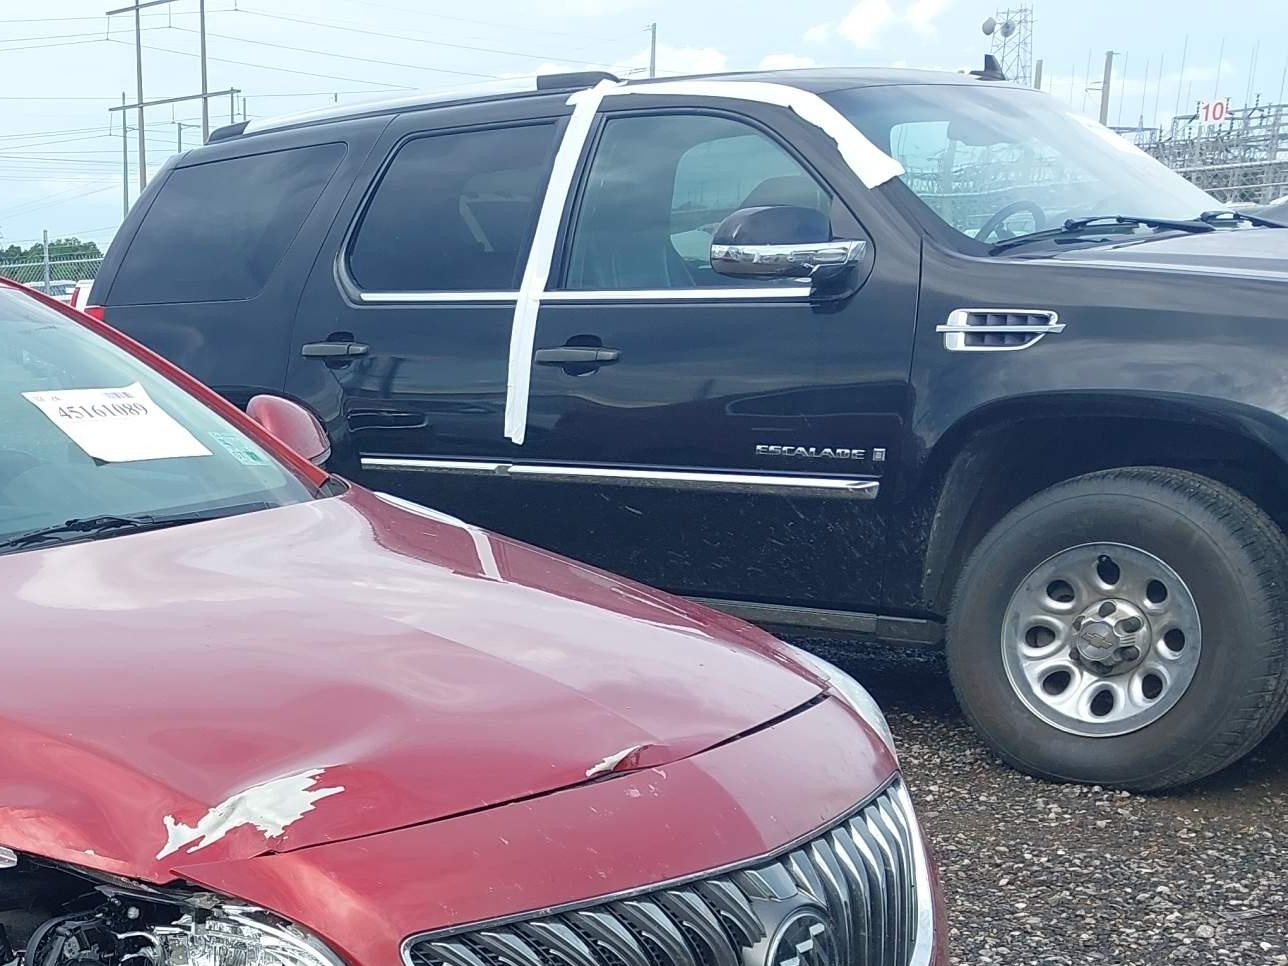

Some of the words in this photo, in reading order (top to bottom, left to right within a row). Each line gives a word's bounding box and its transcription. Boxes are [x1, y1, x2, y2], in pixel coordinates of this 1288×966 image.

[1201, 101, 1225, 122] 10
[58, 402, 148, 420] 45161089
[755, 444, 866, 460] ESCALADE
